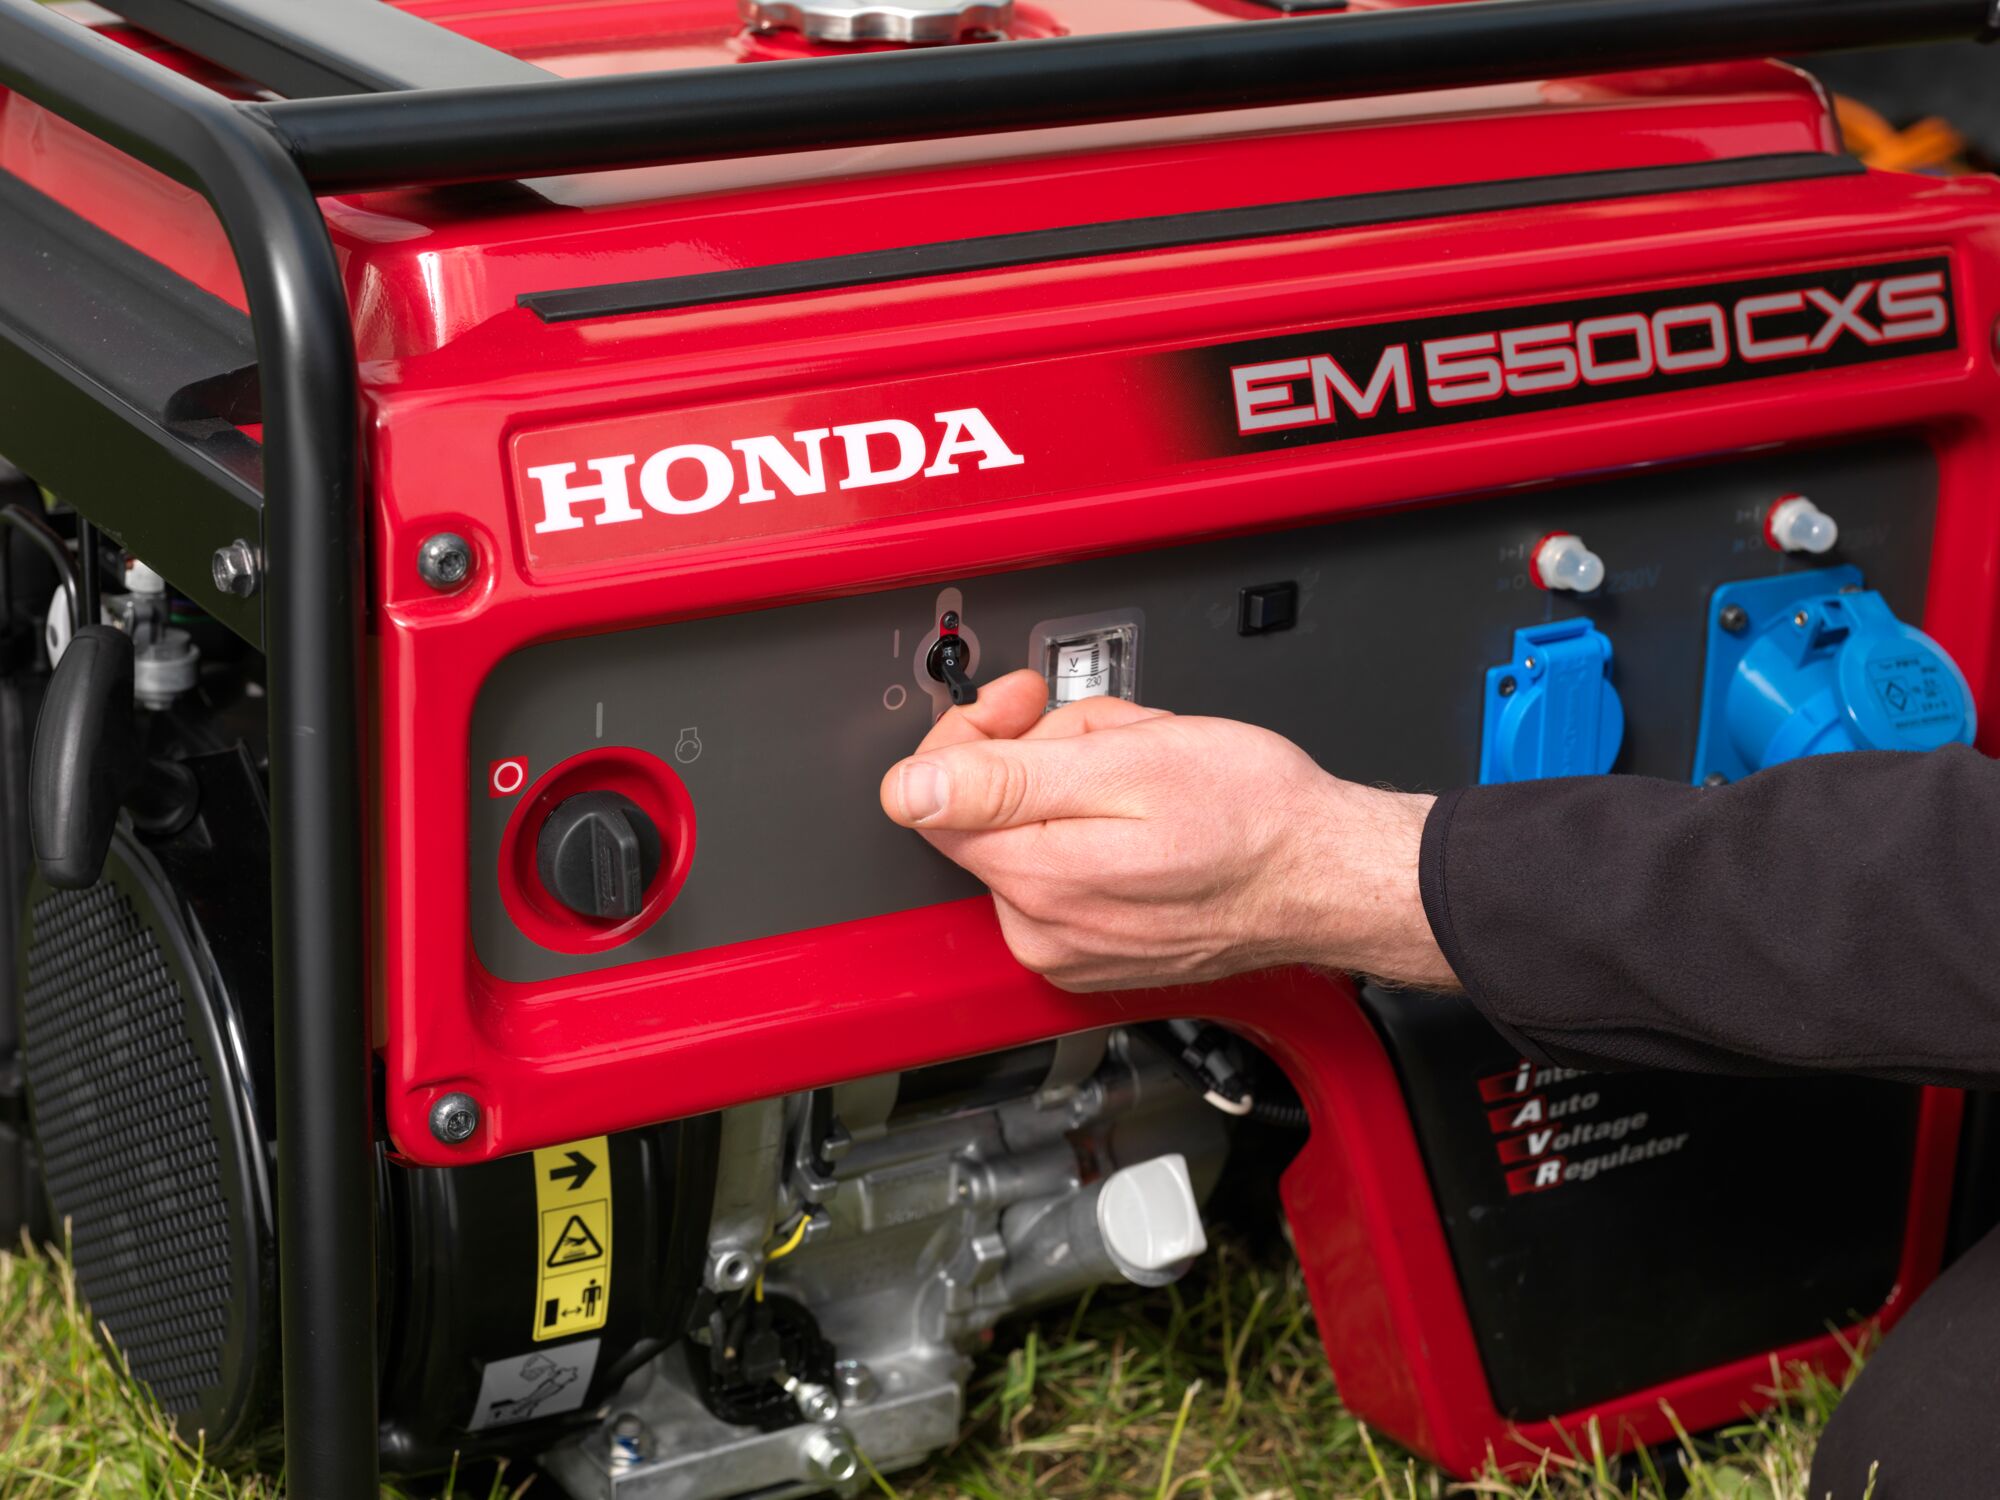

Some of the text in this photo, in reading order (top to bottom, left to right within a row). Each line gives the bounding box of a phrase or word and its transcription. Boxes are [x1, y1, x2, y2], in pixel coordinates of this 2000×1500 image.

[528, 407, 1024, 534] HONDA
[1086, 675, 1102, 688] 230
[1512, 1091, 1600, 1128] Auto
[1528, 1111, 1649, 1156] Voltage
[1535, 1133, 1689, 1187] Regulator
